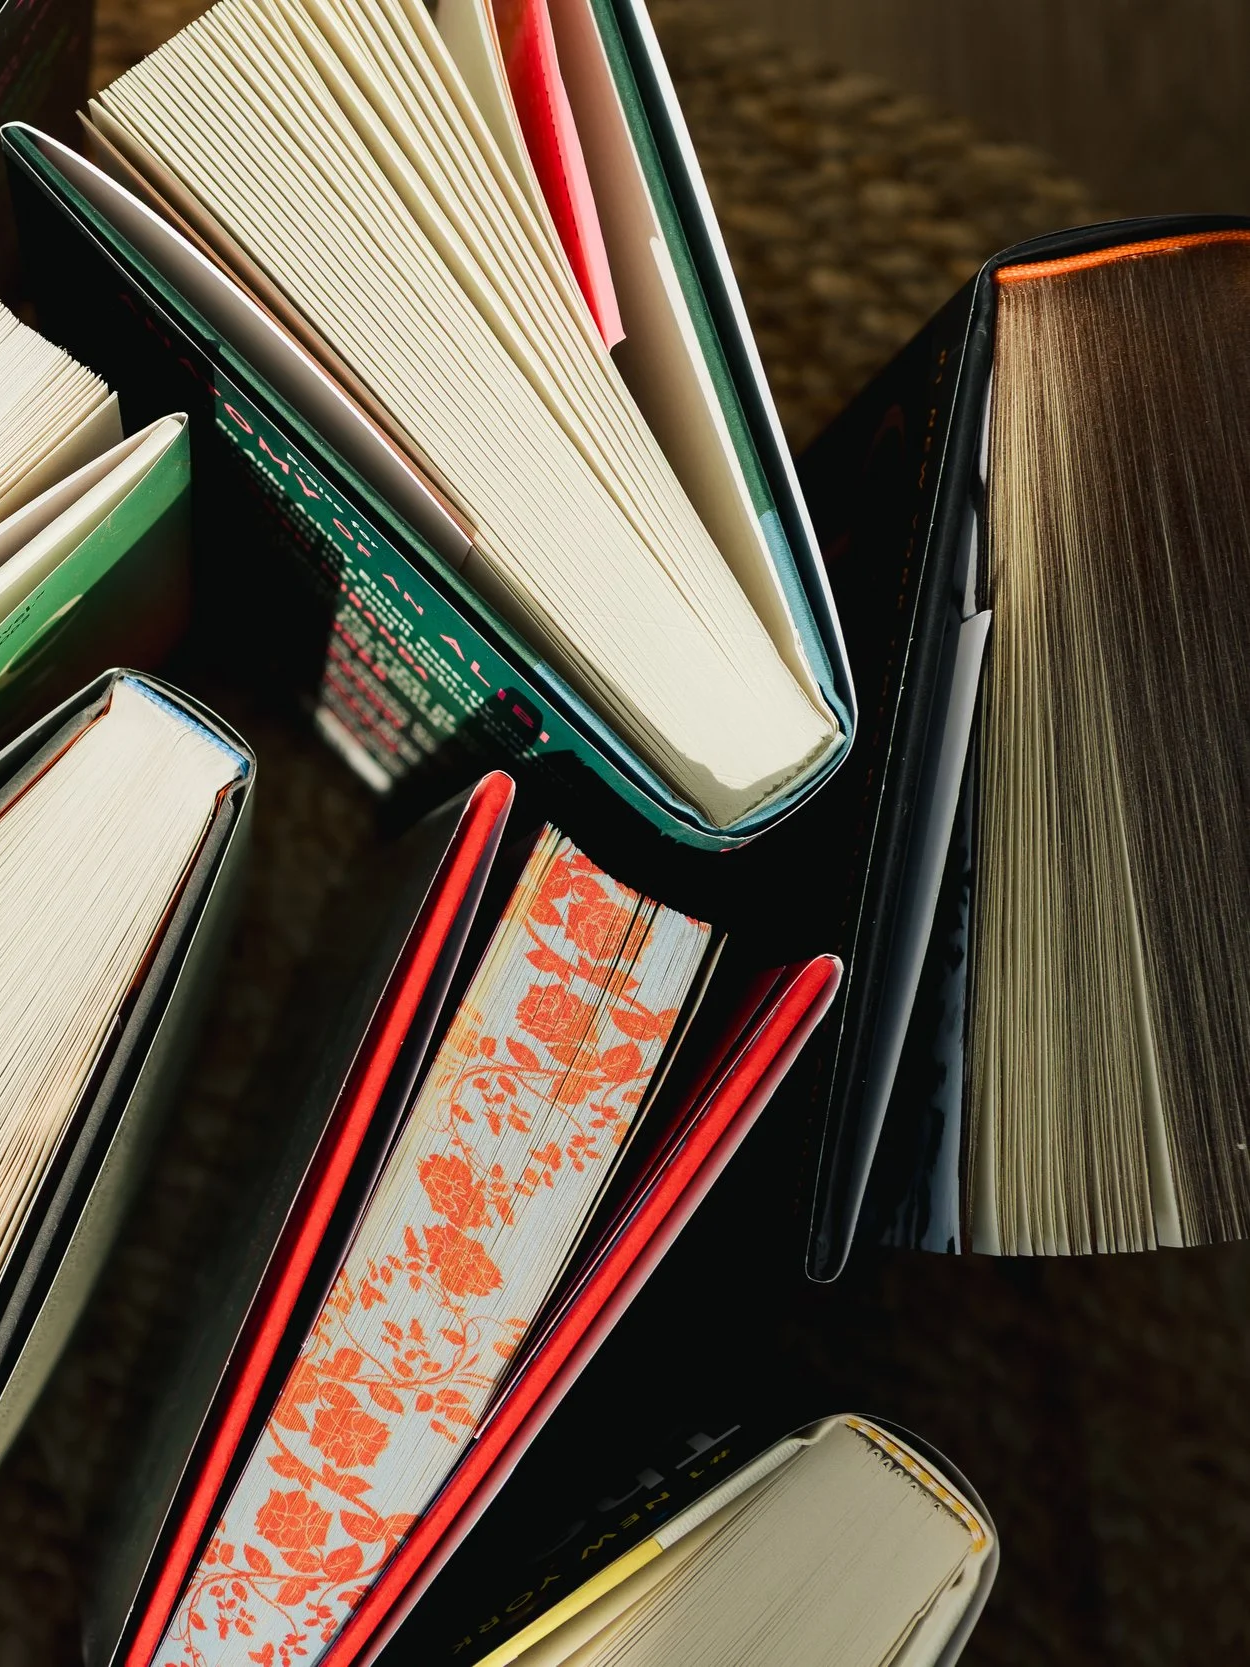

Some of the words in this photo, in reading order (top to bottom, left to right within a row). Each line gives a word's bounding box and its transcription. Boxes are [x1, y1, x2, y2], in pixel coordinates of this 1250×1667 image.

[286, 452, 344, 514] Praise
[351, 520, 379, 549] for
[332, 517, 372, 558] OF
[382, 573, 425, 616] AN
[439, 633, 551, 744] ALIBI
[581, 1490, 670, 1561] NEW
[452, 1573, 562, 1655] YORK
